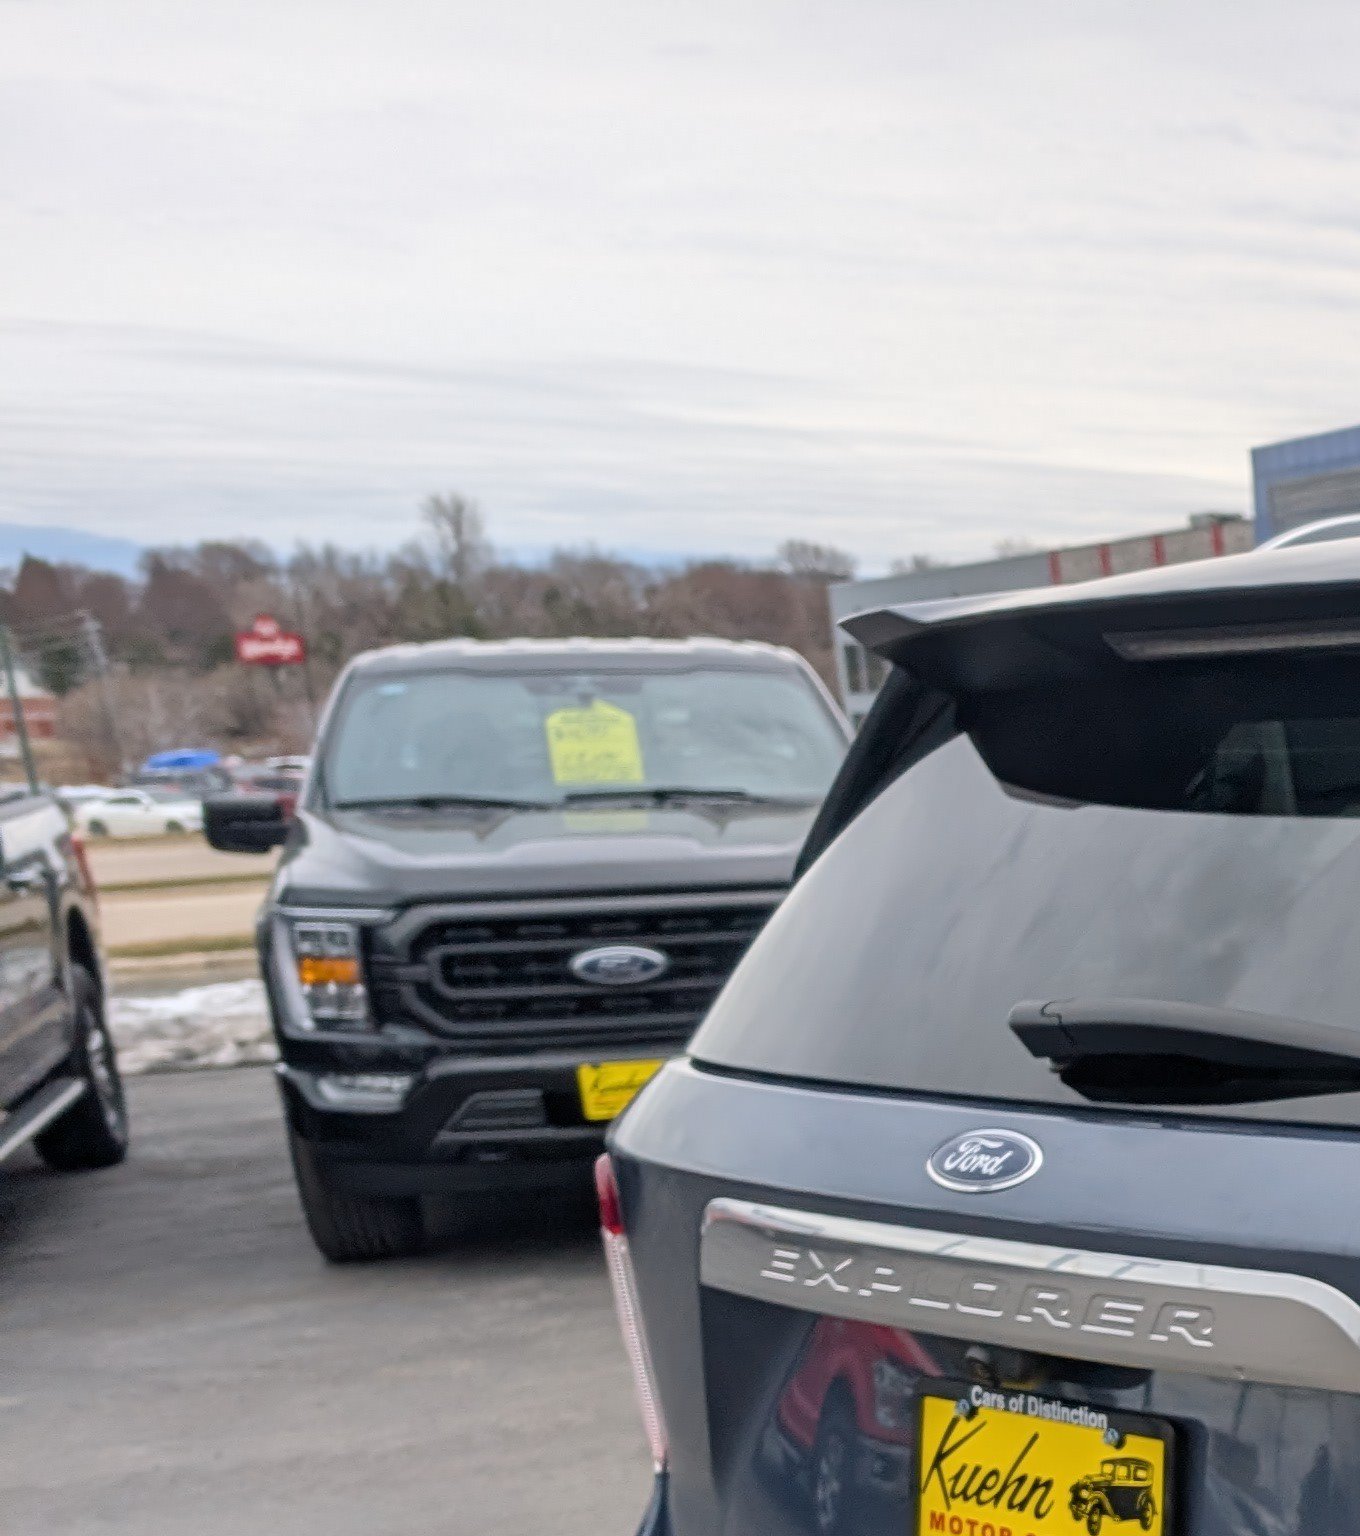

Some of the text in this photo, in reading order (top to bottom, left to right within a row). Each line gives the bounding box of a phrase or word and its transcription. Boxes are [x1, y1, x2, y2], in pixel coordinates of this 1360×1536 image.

[944, 1137, 1013, 1176] Ford
[760, 1249, 1216, 1348] EXPLORER
[971, 1385, 1107, 1430] Cars of Distinction
[922, 1416, 1055, 1519] Kuehn
